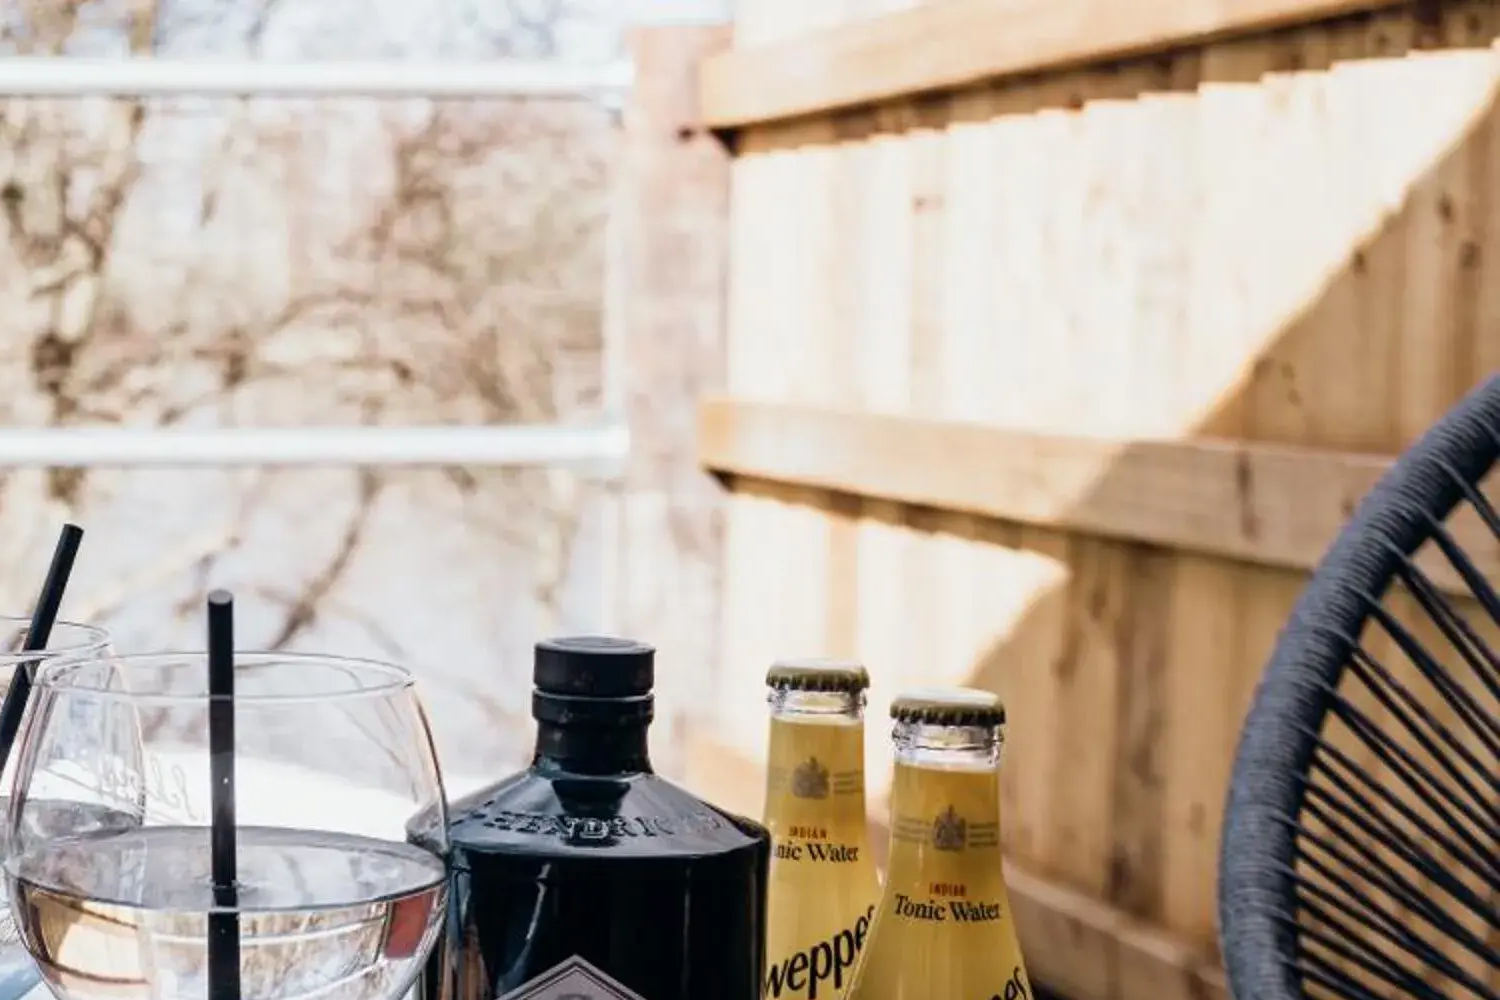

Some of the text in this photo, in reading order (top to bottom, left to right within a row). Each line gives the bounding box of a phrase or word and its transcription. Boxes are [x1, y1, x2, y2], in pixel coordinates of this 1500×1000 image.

[775, 840, 859, 863] nic Water
[894, 892, 1000, 922] Tonic Water
